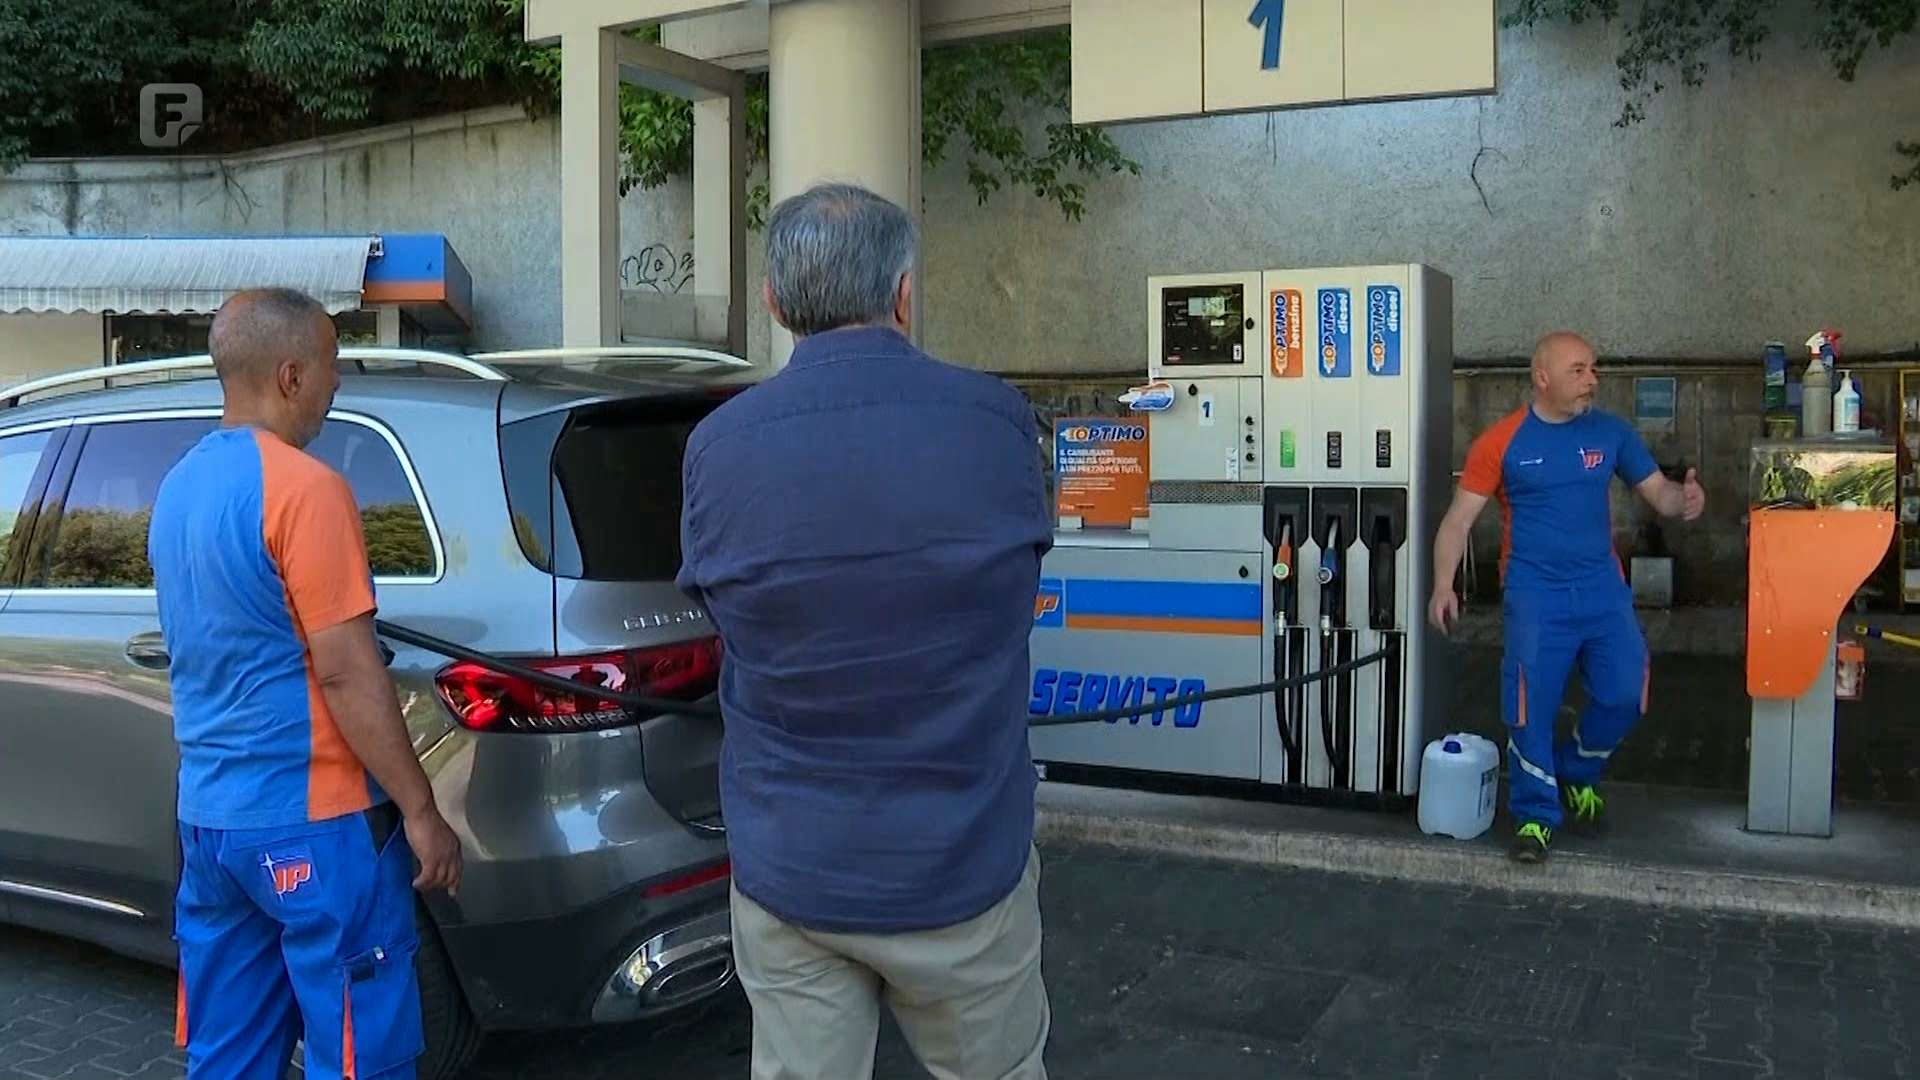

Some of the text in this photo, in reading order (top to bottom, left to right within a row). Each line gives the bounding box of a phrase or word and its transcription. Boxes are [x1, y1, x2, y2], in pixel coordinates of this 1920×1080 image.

[1247, 0, 1284, 71] 1
[1274, 293, 1288, 361] OPTIMO
[1288, 295, 1300, 349] benzina
[1322, 292, 1336, 358] OPTIMO
[1337, 292, 1349, 334] diesel
[1371, 290, 1385, 357] OPTIMO
[1387, 289, 1399, 332] diesel
[1202, 400, 1211, 418] 1
[1073, 425, 1147, 442] OPTIMO
[1077, 465, 1104, 473] PREZZO
[1105, 465, 1120, 473] PER
[1034, 593, 1060, 621] P
[1029, 669, 1205, 728] SERVITO
[271, 859, 311, 896] IP
